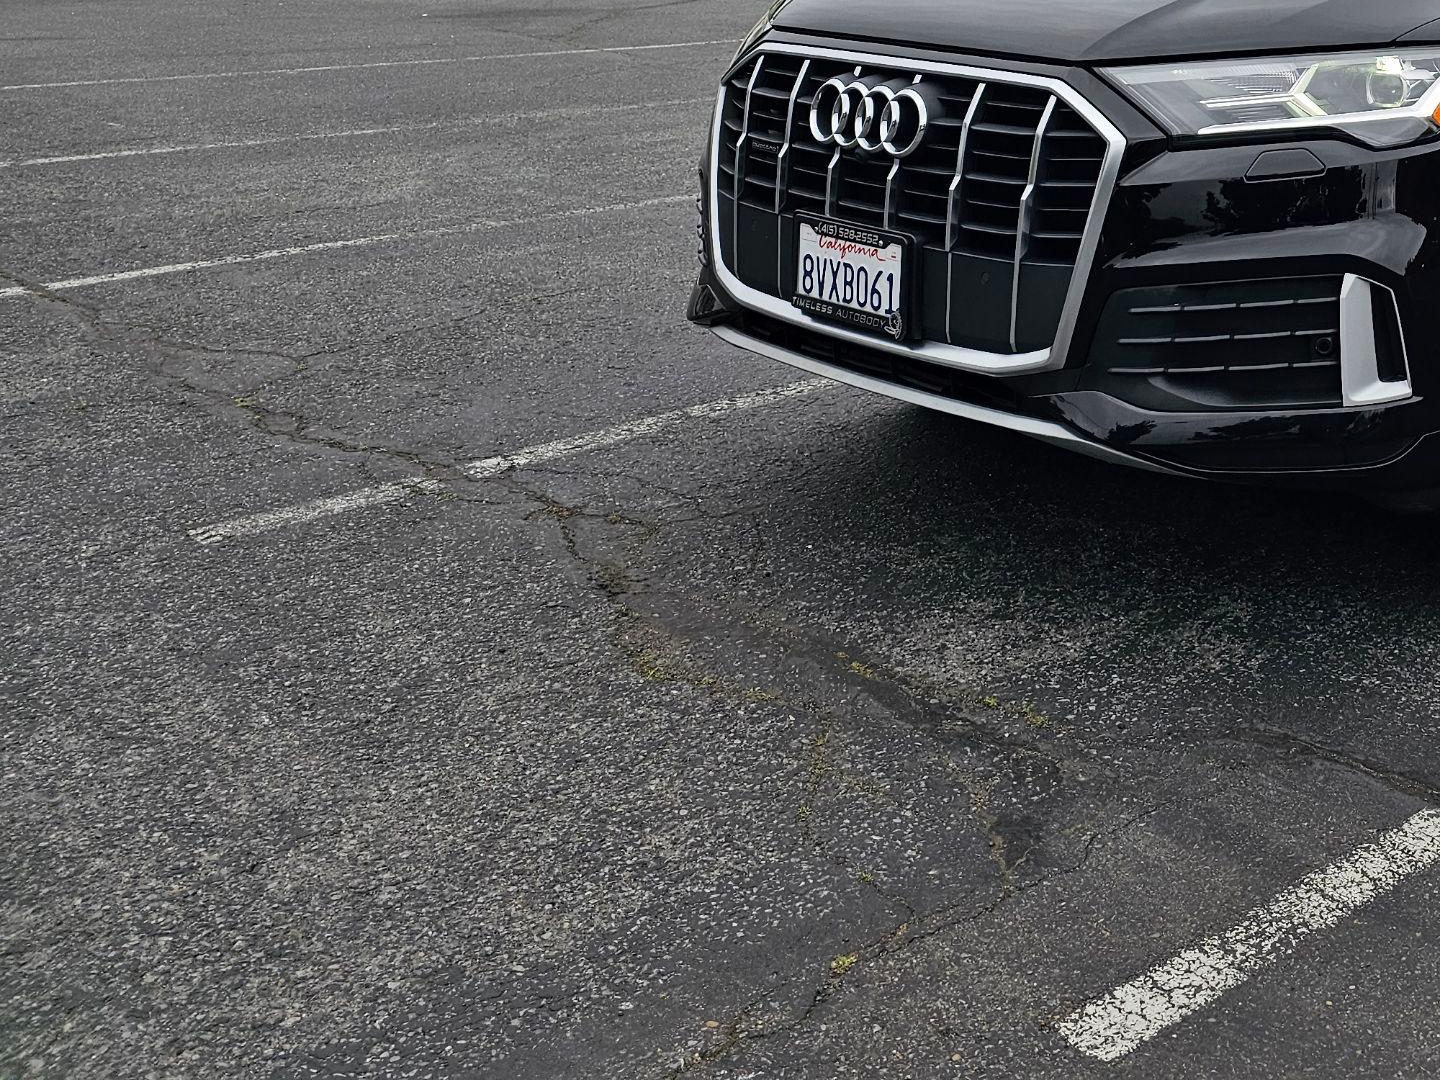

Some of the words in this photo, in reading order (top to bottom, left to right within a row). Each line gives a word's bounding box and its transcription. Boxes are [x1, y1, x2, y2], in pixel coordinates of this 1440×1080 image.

[818, 234, 886, 262] California
[838, 227, 879, 245] 528-2552
[802, 253, 895, 315] 8VXB061
[791, 296, 833, 314] TIMELESS
[835, 308, 885, 328] AUTOBODY
